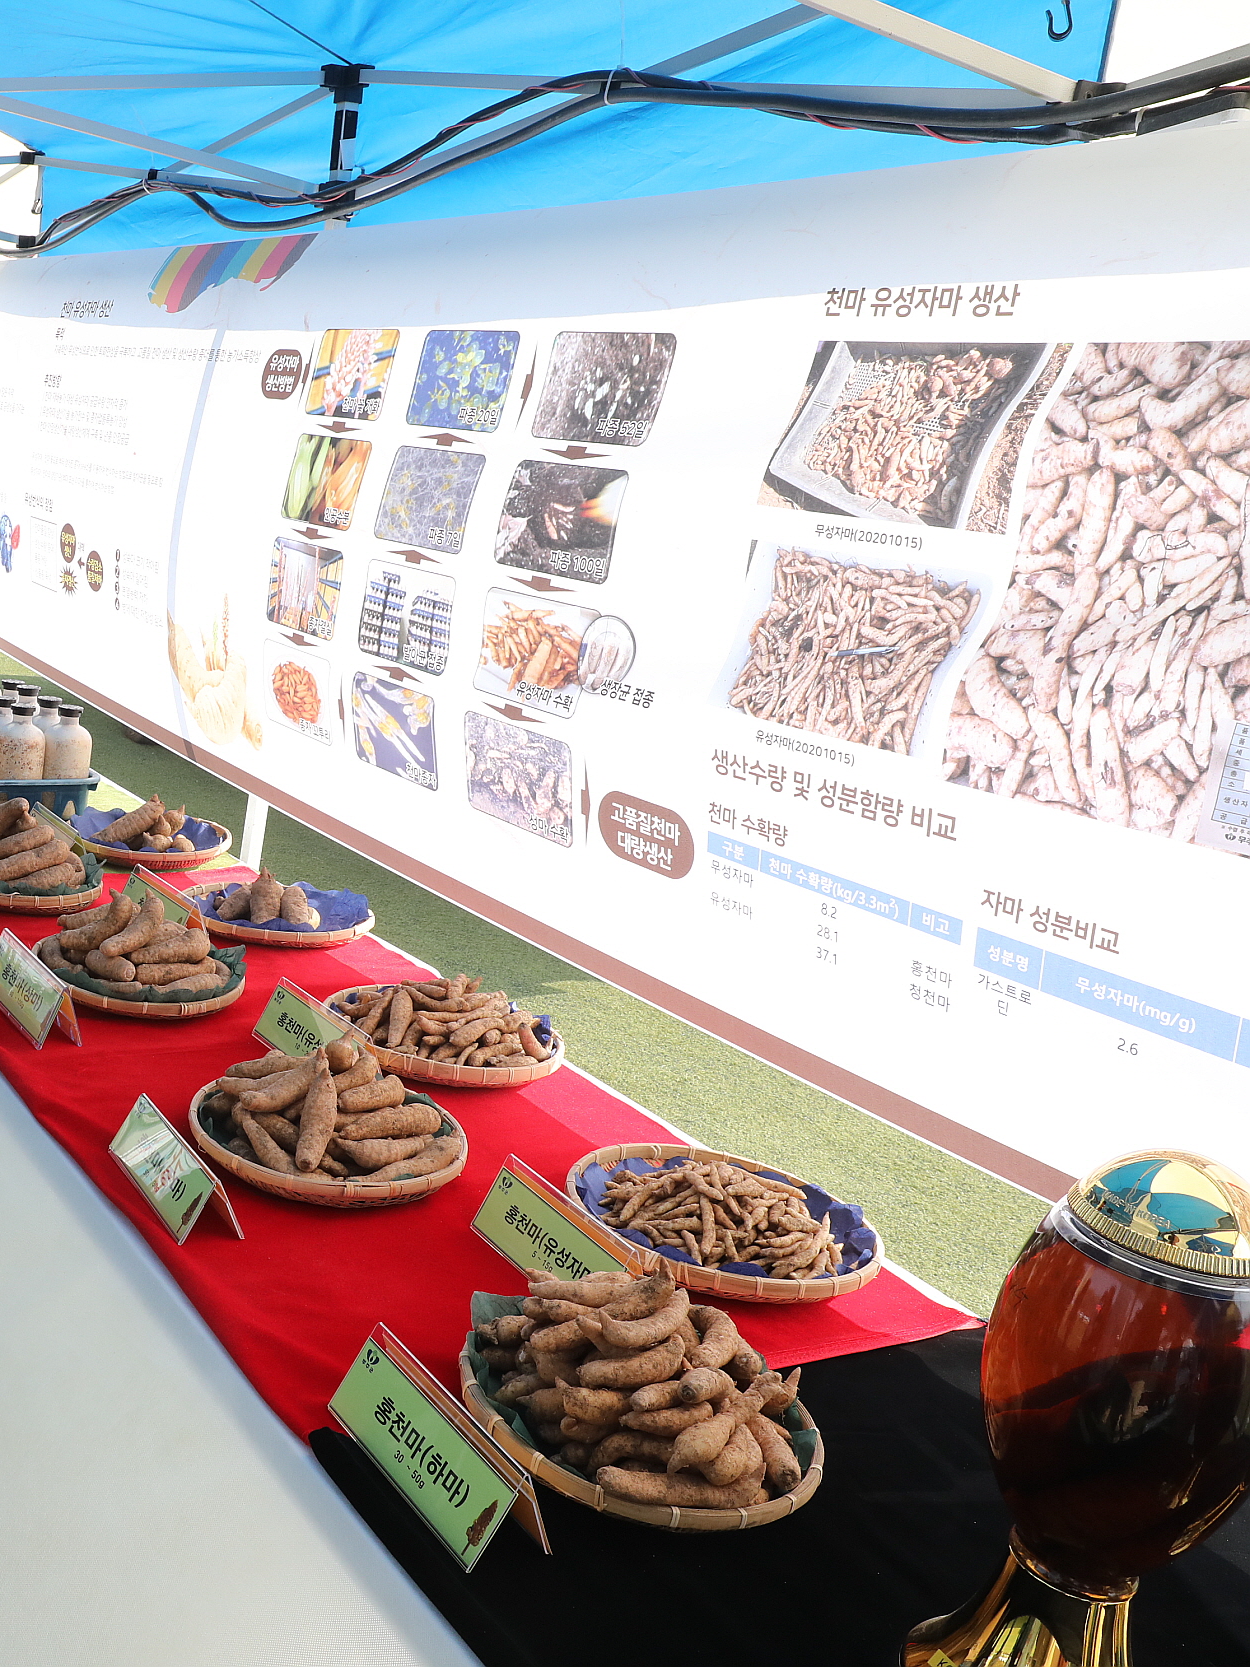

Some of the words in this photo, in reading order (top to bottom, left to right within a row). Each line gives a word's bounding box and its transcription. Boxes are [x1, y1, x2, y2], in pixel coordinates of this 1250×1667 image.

[824, 287, 866, 317] 천마
[870, 285, 963, 317] 유성자마
[968, 284, 1020, 317] 생산
[270, 354, 301, 372] 유성자마
[265, 374, 295, 393] 생산방법
[458, 406, 477, 425] 파종
[477, 407, 500, 426] 20일
[596, 418, 619, 438] 파종
[619, 420, 648, 440] 52일
[324, 507, 350, 526] 인공수분
[428, 526, 446, 546] 파종
[446, 530, 462, 550] 7일
[814, 523, 923, 551] 무성자마(20201015)
[549, 550, 571, 572] 파종
[573, 554, 607, 578] 100일
[402, 643, 426, 666] 발아균
[427, 651, 445, 672] 접종
[516, 681, 553, 706] 유성자마
[553, 693, 573, 713] 수확
[599, 679, 632, 702] 생장균
[631, 688, 656, 709] 접종
[755, 730, 856, 768] 유성자마(20201015)
[711, 749, 787, 793] 생산수량
[793, 770, 811, 801] 및
[818, 779, 904, 828] 성분함량
[910, 805, 957, 842] 비교
[528, 815, 549, 836] 성마
[550, 825, 570, 844] 수확
[609, 802, 681, 847] 고품질천마
[708, 801, 737, 830] 천마
[740, 815, 789, 847] 수확량
[617, 831, 674, 871] 대량생산
[721, 840, 745, 861] 구분
[710, 859, 754, 888] 무성자마
[768, 857, 793, 879] 천마
[710, 891, 753, 920] 유성자마
[821, 902, 837, 919] 8.2
[816, 924, 838, 943] 28.1
[921, 912, 951, 936] 비고
[980, 888, 1024, 925] 자마
[1029, 905, 1120, 955] 성분비교
[816, 946, 837, 965] 37.1
[987, 943, 1030, 973] 성분명
[910, 959, 953, 989] 홍천마
[909, 983, 952, 1013] 청천마
[977, 973, 1032, 1006] 가스트로
[997, 1000, 1008, 1017] 딘
[1075, 975, 1196, 1034] 무성자마(mg/g)
[276, 1012, 325, 1051] 홍천마(유성
[1117, 1037, 1139, 1056] 2.6
[1102, 1189, 1125, 1208] MADE
[1136, 1209, 1171, 1230] KOREA
[531, 1250, 538, 1258] 5
[373, 1396, 470, 1509] 홍천마(하마)
[393, 1449, 405, 1464] 30
[410, 1469, 426, 1490] 50g
